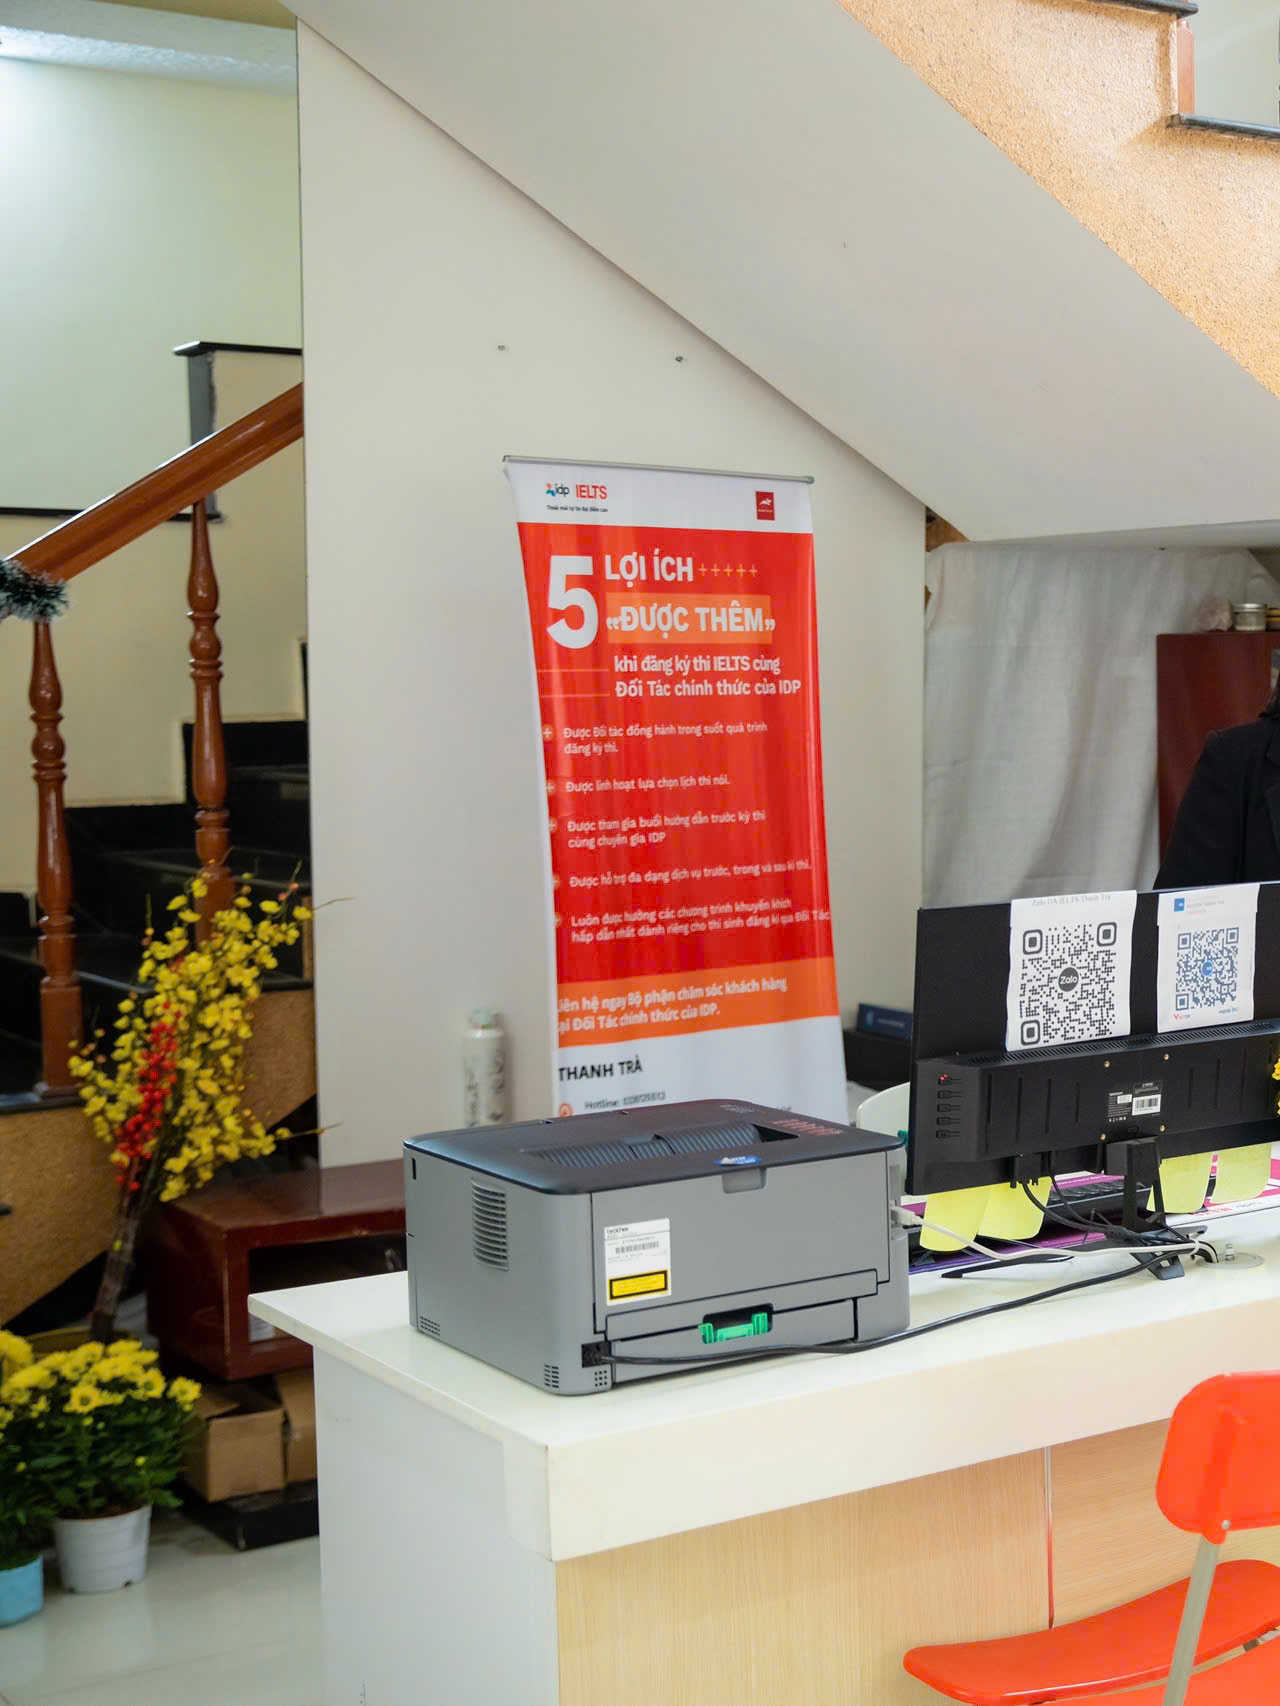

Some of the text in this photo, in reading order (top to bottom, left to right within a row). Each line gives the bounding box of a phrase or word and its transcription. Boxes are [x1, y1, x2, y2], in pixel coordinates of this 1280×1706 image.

[555, 484, 608, 499] idp IELTS
[605, 548, 693, 588] LỢI ÍCH
[546, 555, 599, 649] 5
[614, 654, 781, 676] khi đăng ký thi IELTS cùng
[615, 678, 801, 697] Đối Tác chính thức của IDP
[563, 727, 591, 740] Được
[678, 725, 702, 737] trong
[703, 721, 724, 734] suốt
[565, 781, 594, 794] Được
[612, 778, 635, 792] hoạt
[638, 777, 654, 791] lựa
[657, 777, 678, 790] chọn
[680, 776, 696, 789] lịch
[698, 775, 711, 786] thi
[567, 820, 596, 834] Được
[752, 809, 766, 821] thi
[630, 832, 646, 847] gia
[648, 832, 666, 843] IDP
[569, 876, 599, 890] Được
[628, 871, 642, 884] đa
[644, 869, 670, 884] dạng
[733, 864, 760, 877] trong
[571, 913, 600, 928] Luôn
[690, 920, 707, 932] cho
[1059, 975, 1078, 985] Zalo
[582, 996, 599, 1013] hệ
[725, 979, 760, 994] khách
[597, 1014, 618, 1029] Tác
[558, 1063, 613, 1082] THANH
